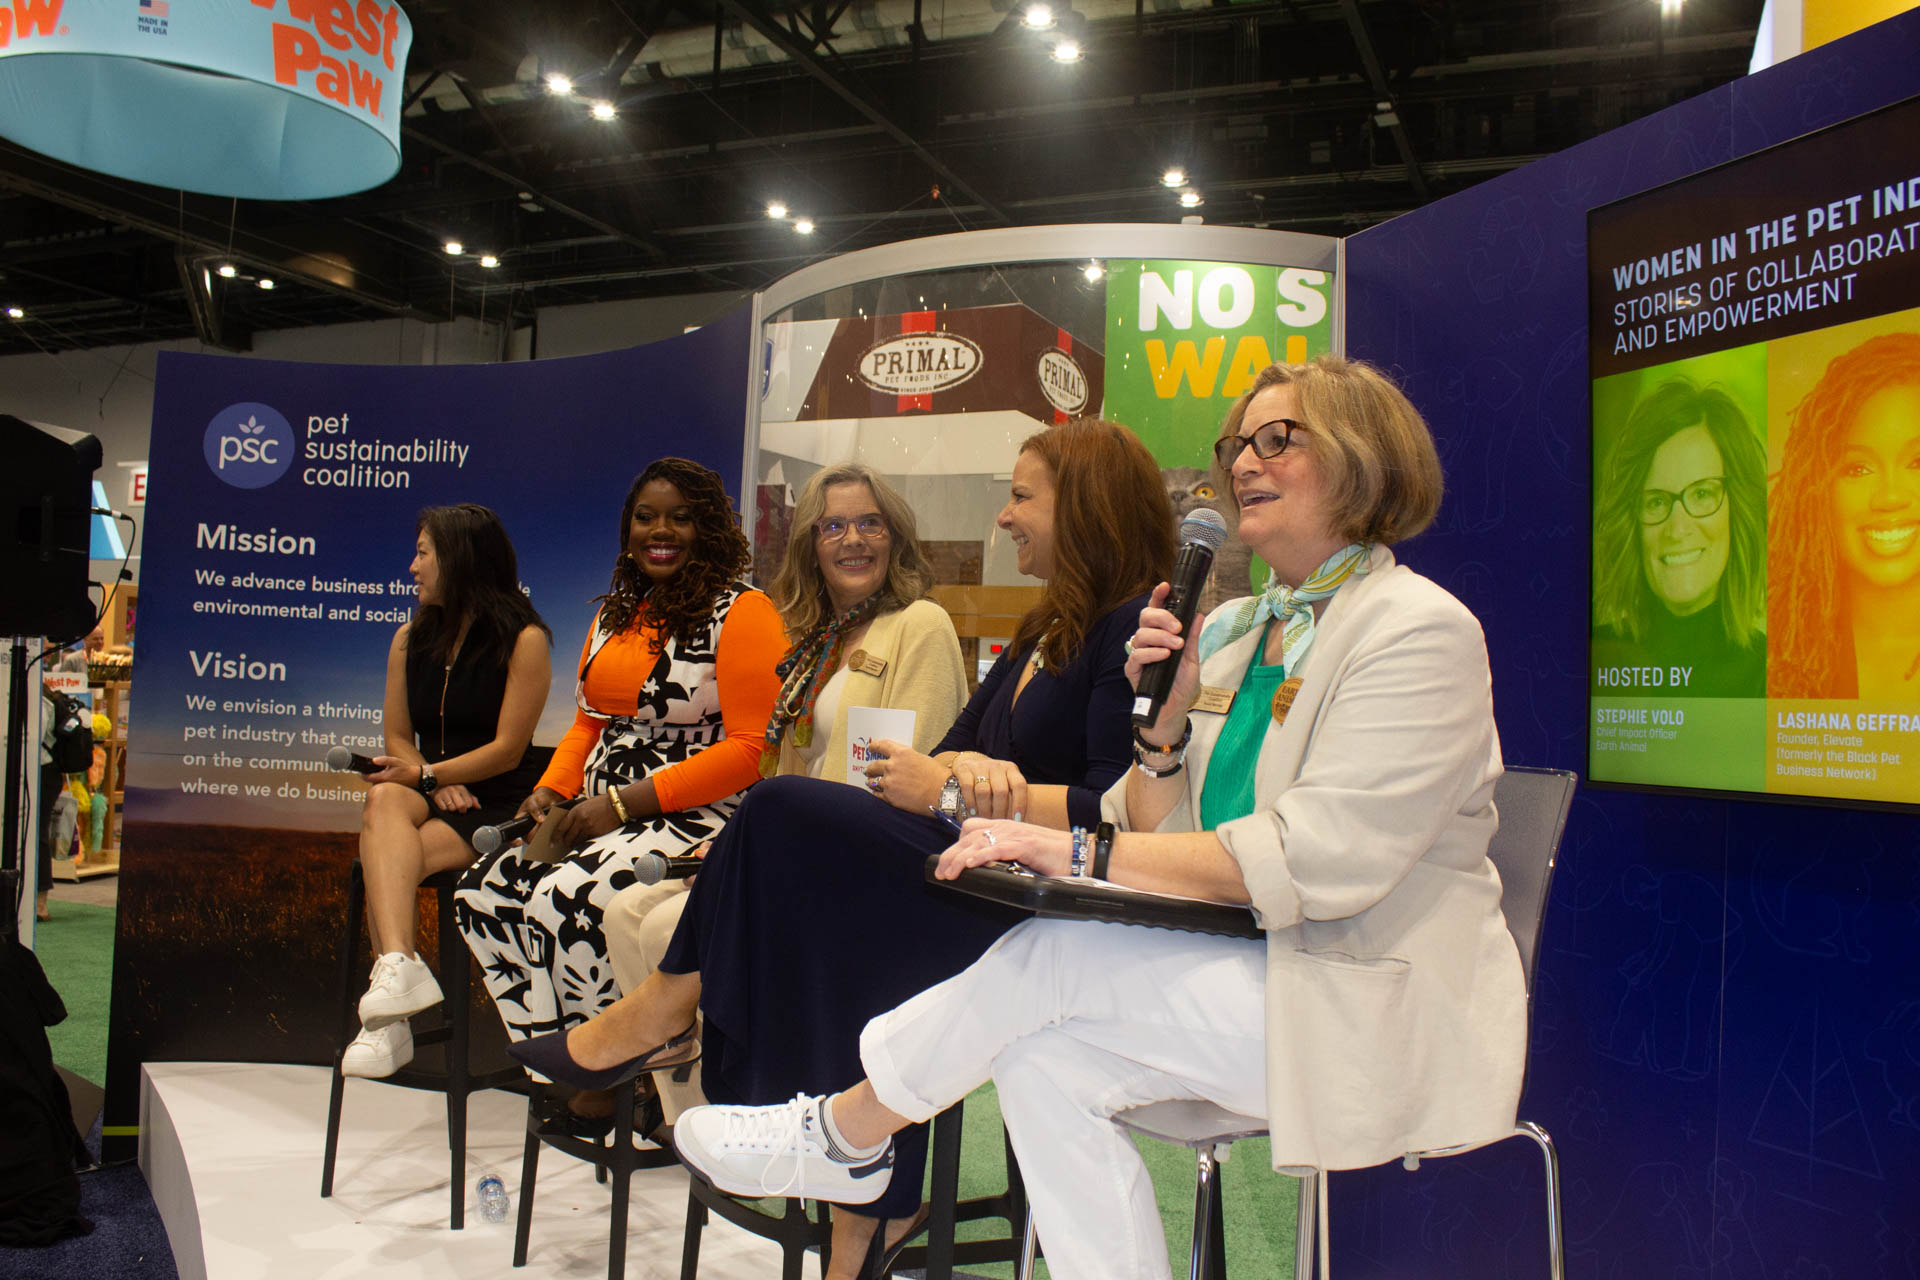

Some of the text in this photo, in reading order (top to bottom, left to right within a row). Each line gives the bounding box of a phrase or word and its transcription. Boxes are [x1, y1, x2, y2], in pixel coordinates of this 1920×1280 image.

[137, 24, 168, 36] THE USA
[138, 16, 169, 28] MADE IN
[272, 22, 383, 117] Paw
[1612, 176, 1920, 292] WOMEN IN THE PET IND
[1614, 222, 1920, 326] STORIES OF COLLABORAT
[1138, 266, 1255, 331] NO
[1614, 273, 1858, 356] AND EMPOWERMENT
[873, 347, 966, 376] PRIMAL
[1044, 358, 1082, 400] PRIMAL
[307, 413, 350, 439] pet
[219, 435, 279, 470] psc
[305, 438, 470, 468] sustainability
[303, 464, 411, 488] coalition
[196, 523, 316, 555] Mission
[195, 569, 225, 587] We
[232, 572, 306, 591] advance
[312, 577, 384, 595] business
[193, 599, 412, 623] environmental and social
[189, 650, 287, 681] Vision
[1598, 666, 1693, 687] HOSTED BY
[186, 695, 383, 724] We envision a thriving
[1597, 709, 1684, 725] STEPHIE VOLO
[1596, 727, 1677, 740] Chief Impact Officer
[1778, 712, 1920, 732] LASHANA GEFFRA
[184, 725, 216, 742] pet
[222, 725, 296, 746] industry
[301, 728, 337, 746] that
[1596, 739, 1647, 753] Earth Animal
[1777, 732, 1863, 747] Founder, Elevate
[183, 752, 361, 774] on the communi
[1776, 763, 1823, 777] Business
[1826, 751, 1844, 762] the
[1847, 751, 1878, 764] Black
[1881, 752, 1902, 765] Pet
[181, 779, 239, 797] where
[245, 784, 271, 798] we
[278, 781, 301, 799] do
